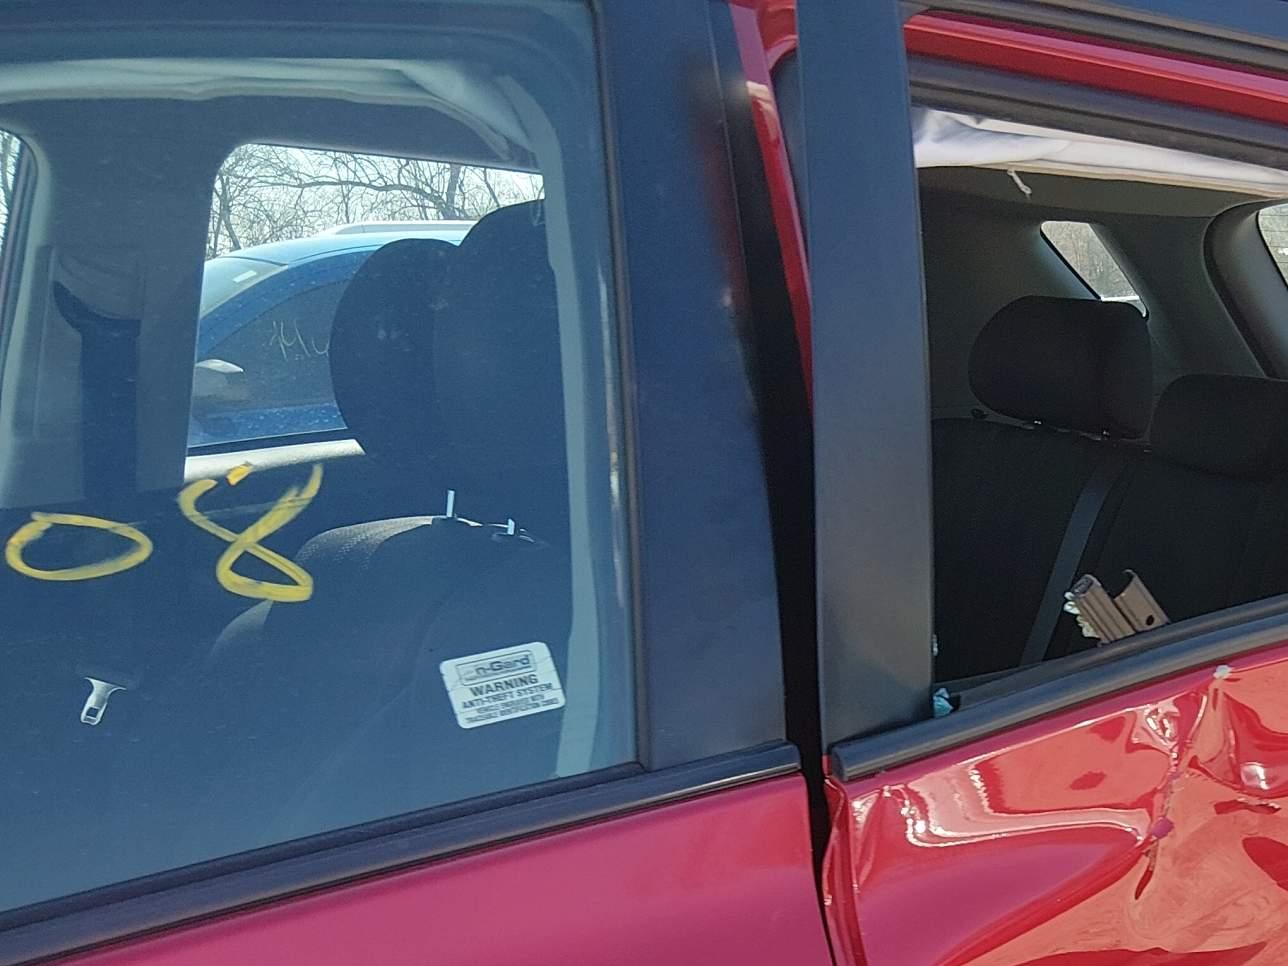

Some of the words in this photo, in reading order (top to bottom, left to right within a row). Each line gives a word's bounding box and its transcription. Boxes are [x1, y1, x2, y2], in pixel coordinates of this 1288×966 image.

[463, 690, 514, 708] ANTI-THEFT
[517, 682, 553, 697] SYSTEM
[470, 674, 538, 697] WARNING
